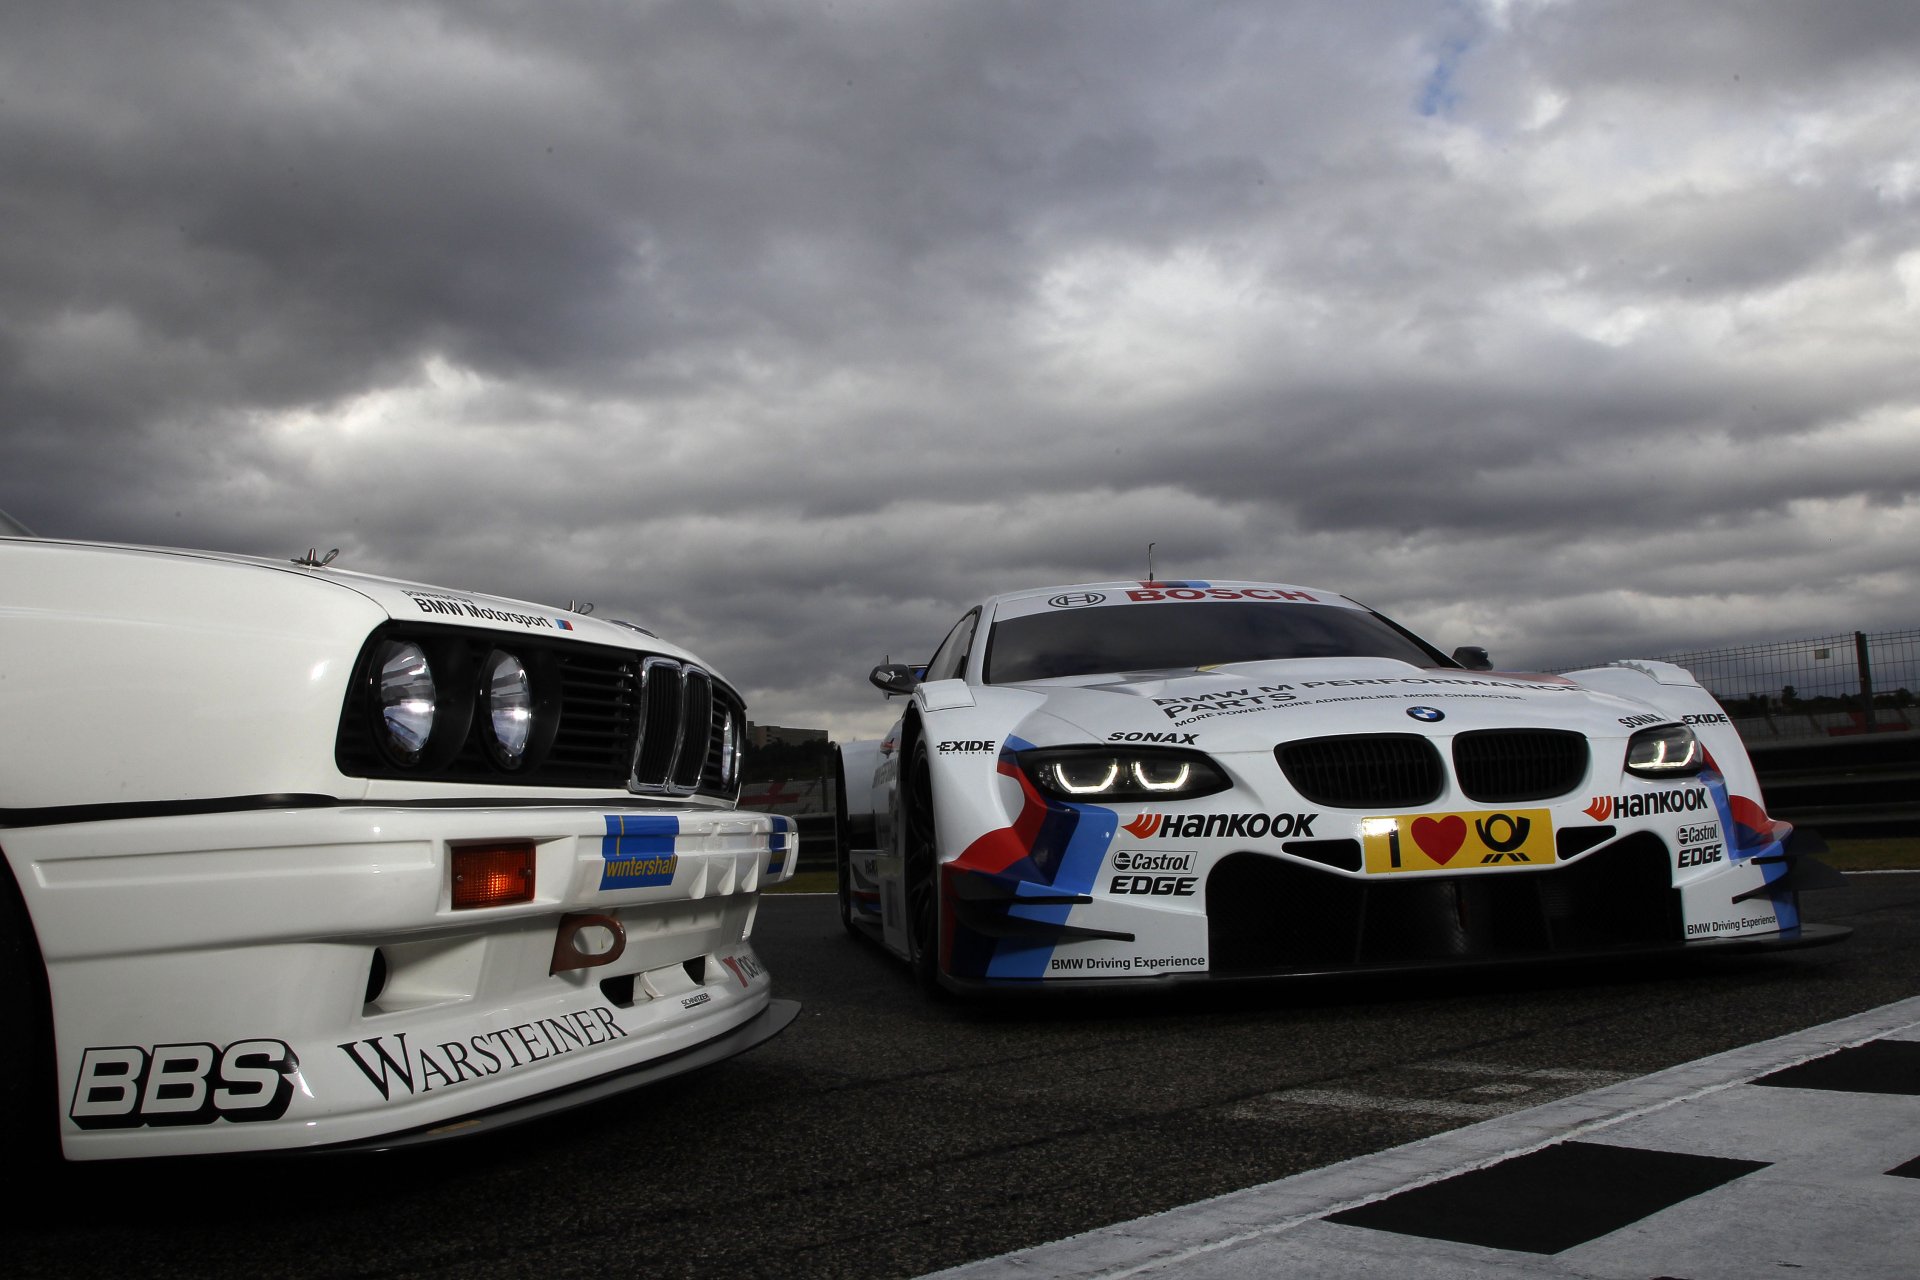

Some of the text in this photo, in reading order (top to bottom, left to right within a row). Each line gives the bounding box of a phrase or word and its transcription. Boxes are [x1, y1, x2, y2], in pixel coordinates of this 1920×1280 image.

[1124, 588, 1320, 602] BOSCH
[413, 597, 553, 628] BMW Motorsport
[1153, 679, 1592, 706] BMW M PERFORMANCE
[1162, 693, 1296, 719] PARTS
[1174, 712, 1214, 728] MORE
[1272, 700, 1313, 710] MORE
[1618, 713, 1667, 729] SONAX
[1681, 713, 1729, 725] EXIDE
[937, 740, 996, 752] EXIDE
[1107, 732, 1200, 745] SONAX
[1688, 823, 1718, 843] Castrol
[606, 853, 679, 878] wintershall
[1131, 852, 1190, 871] Castrol
[1677, 843, 1722, 869] EDGE
[1109, 875, 1200, 896] EDGE
[1686, 915, 1776, 935] BMW Driving Experience
[1051, 956, 1206, 970] BMW Driving Experience
[69, 1038, 300, 1130] BBS
